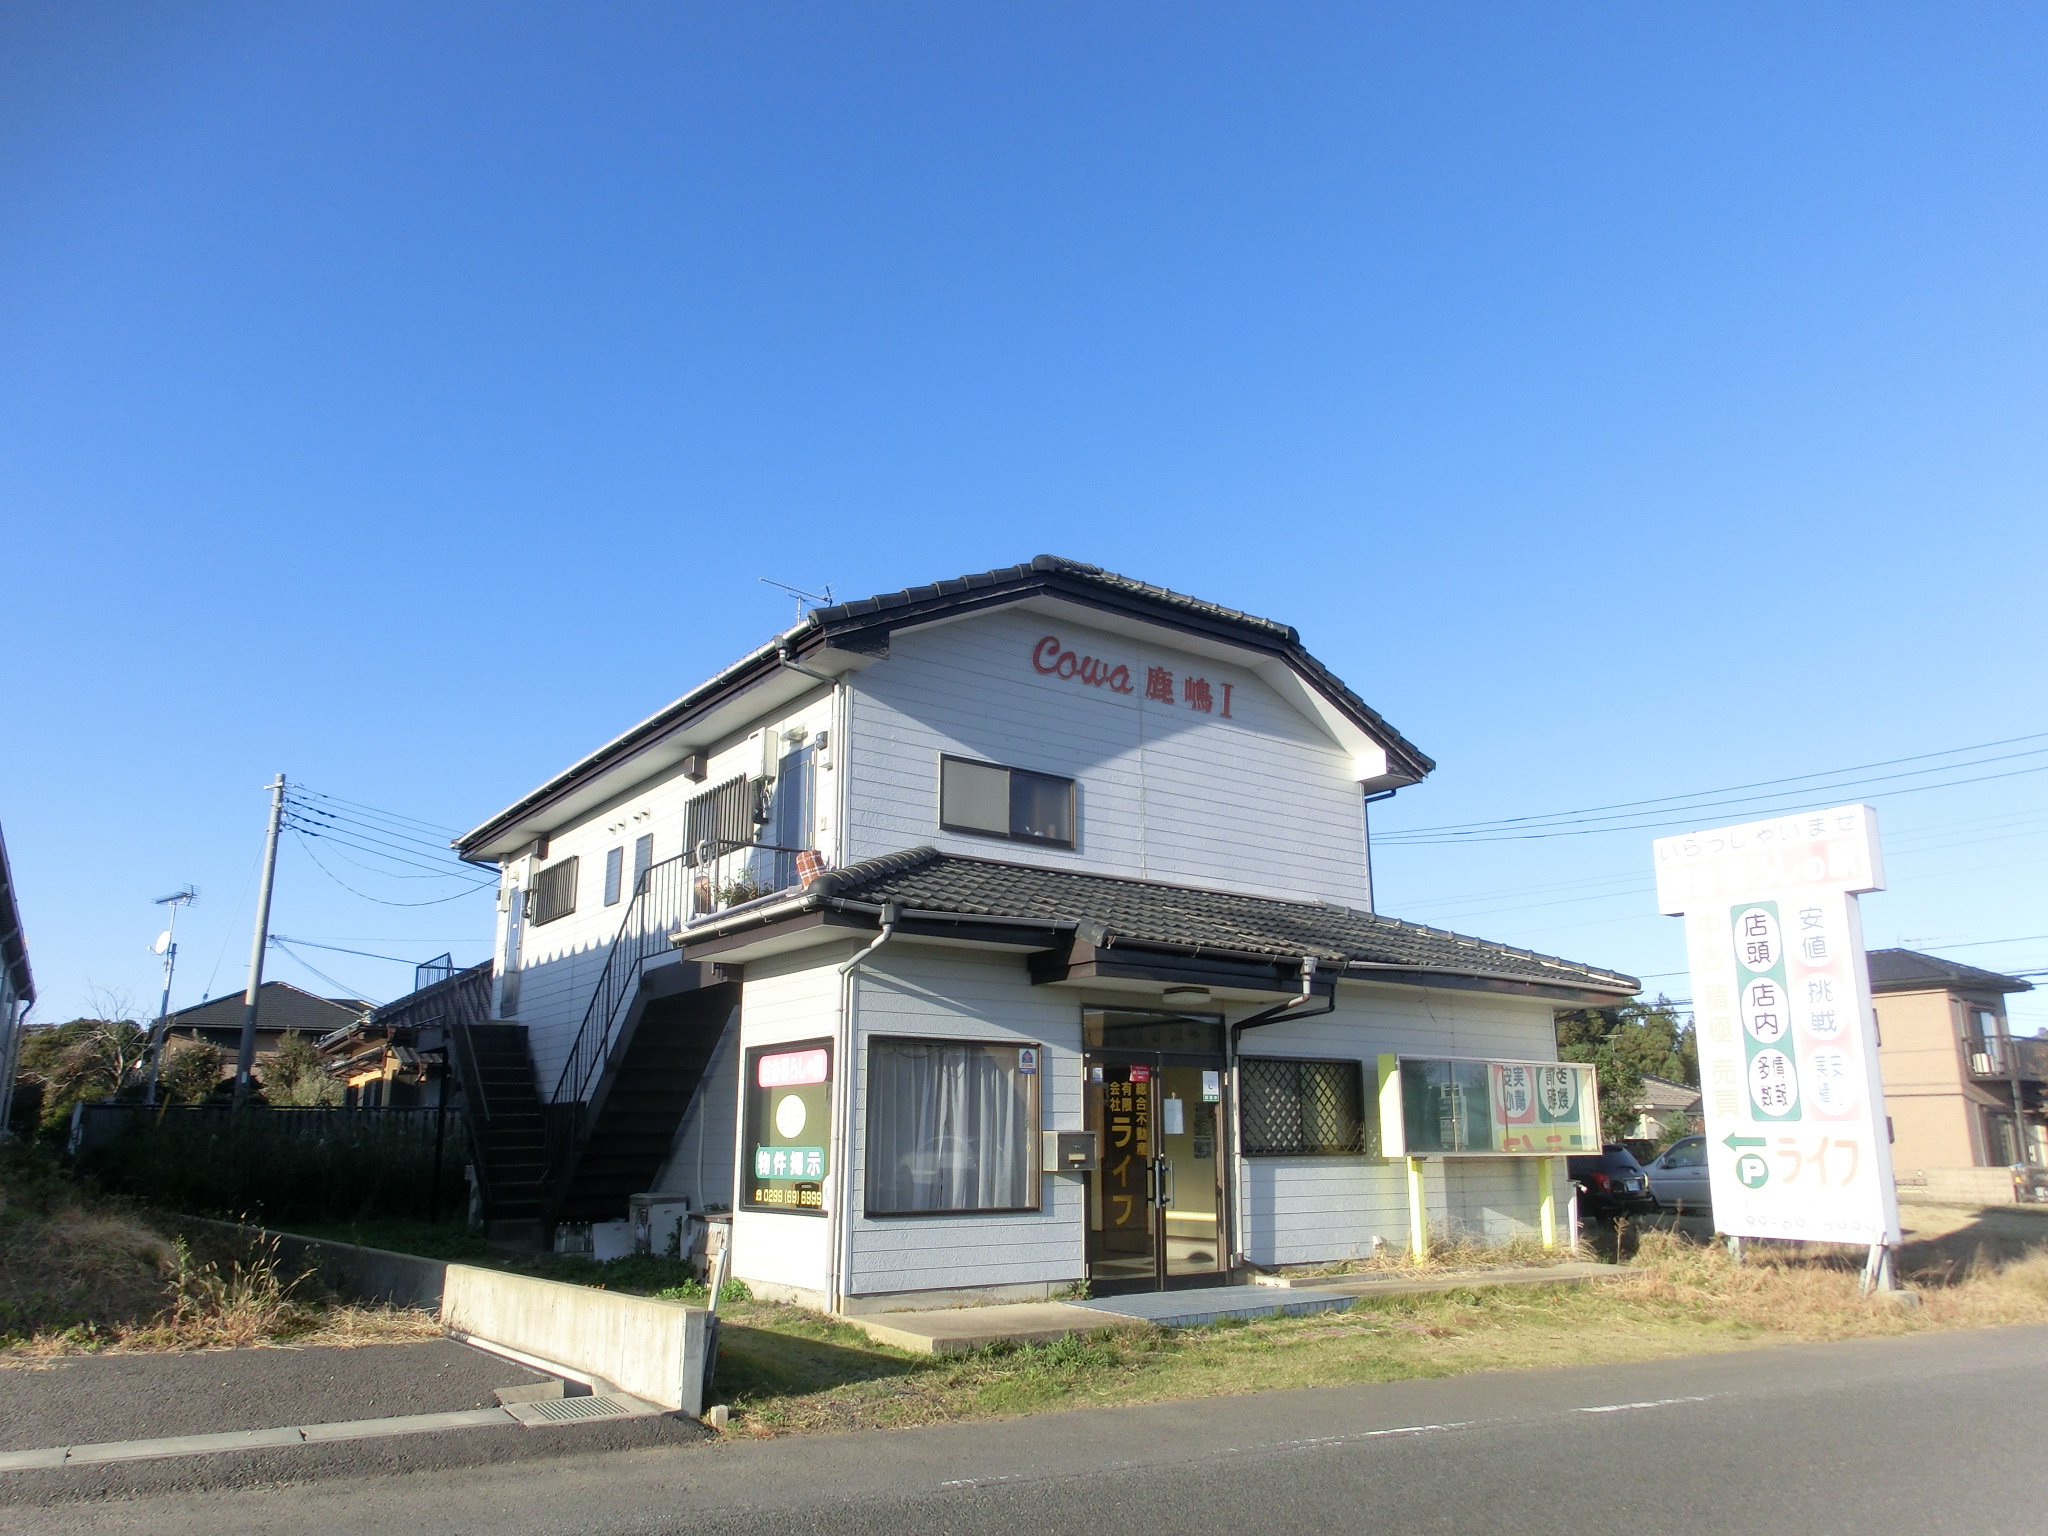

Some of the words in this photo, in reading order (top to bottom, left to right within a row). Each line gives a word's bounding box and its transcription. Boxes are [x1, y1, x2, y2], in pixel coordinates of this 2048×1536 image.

[1032, 636, 1134, 694] Cowa
[1660, 814, 1855, 861] いらっしゃいませ
[1696, 914, 1724, 972] 中古
[1744, 914, 1771, 964] 店頭
[1799, 908, 1828, 959] 安値
[1751, 984, 1778, 1035] 店内
[1808, 980, 1837, 1033] 挑戦
[1109, 1081, 1121, 1112] 会社
[1121, 1081, 1132, 1112] 有限
[1135, 1081, 1148, 1156] 総合不動産
[1111, 1116, 1134, 1226] ライフ
[1776, 1135, 1859, 1187] ライフ
